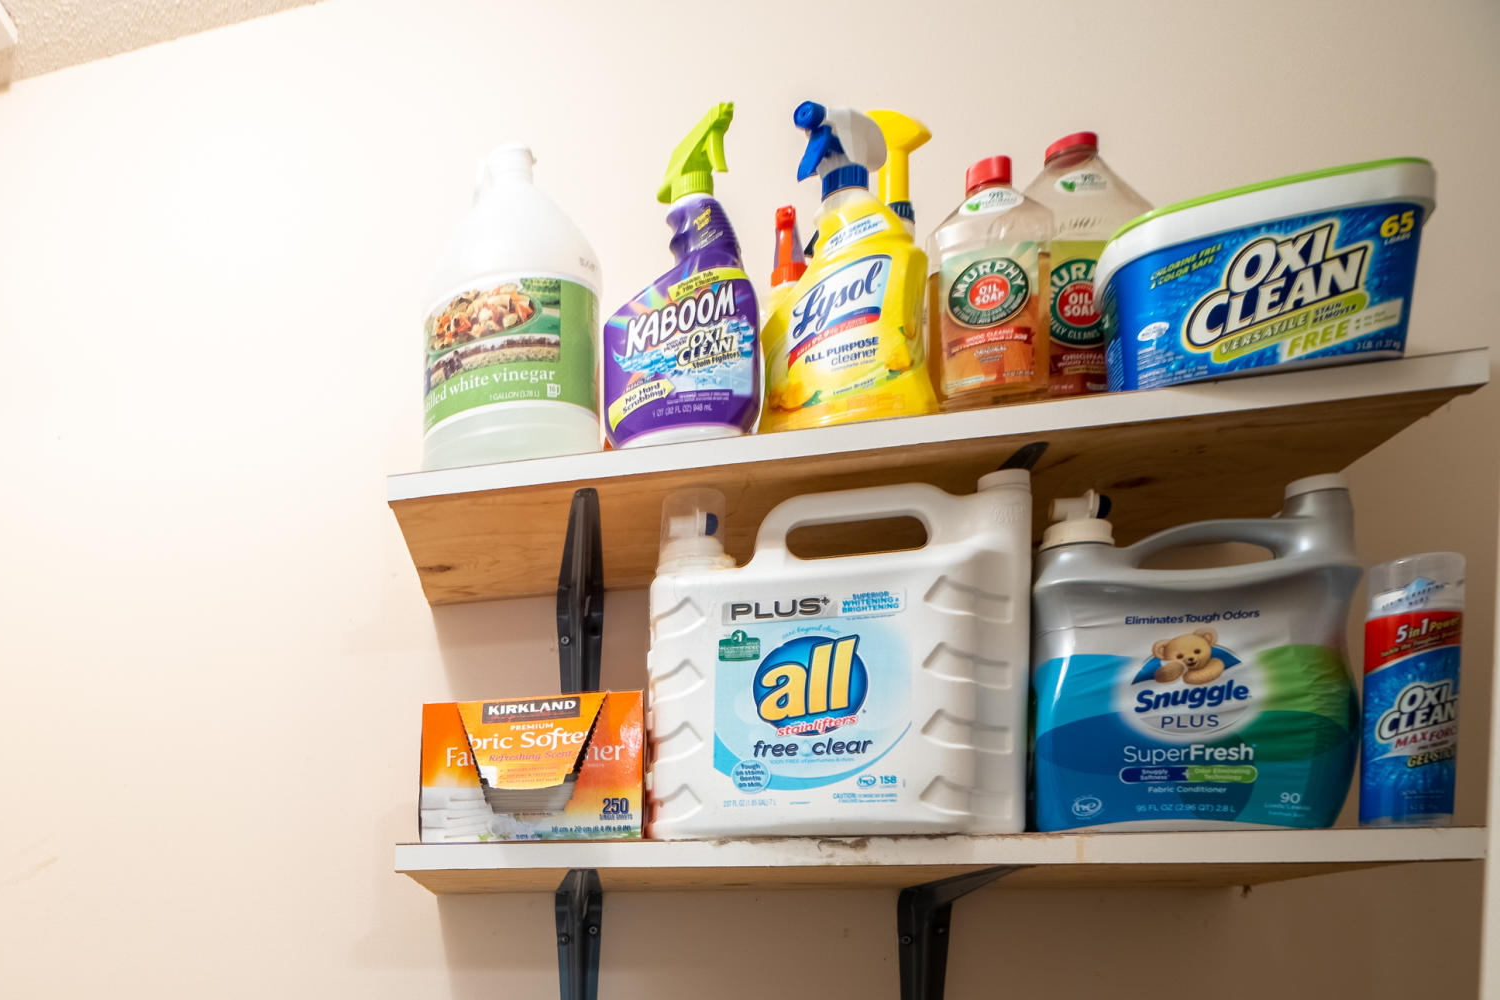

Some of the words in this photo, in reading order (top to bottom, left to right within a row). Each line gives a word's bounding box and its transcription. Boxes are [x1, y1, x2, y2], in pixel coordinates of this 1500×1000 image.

[1380, 211, 1415, 238] 65
[1151, 253, 1197, 280] CHLORINE
[1199, 243, 1222, 259] FREE
[1227, 223, 1333, 293] OXI
[953, 261, 1026, 298] MURPHY
[1157, 265, 1190, 285] COLOR
[1191, 256, 1214, 271] SAFE
[792, 260, 883, 339] Lysol
[975, 290, 1005, 305] SOAP
[979, 284, 999, 295] OIL
[1069, 293, 1092, 304] OIL
[1187, 246, 1368, 346] CLEAN
[1314, 304, 1357, 323] REMOVER
[1315, 303, 1341, 315] STAIN
[625, 281, 735, 358] KABOOM
[689, 327, 720, 348] OXI
[1219, 314, 1308, 355] VERSATILE
[1288, 320, 1349, 357] FREE
[677, 335, 734, 366] CLEAN
[693, 358, 710, 369] Stain
[712, 351, 740, 364] Fighters
[805, 351, 824, 364] ALL
[827, 336, 879, 356] PURPOSE
[831, 348, 878, 366] cleaner
[450, 374, 489, 396] white
[493, 368, 556, 383] vinegar
[625, 394, 637, 405] No
[639, 383, 660, 395] Hard
[842, 597, 894, 606] WHITENING
[852, 591, 889, 599] SUPERIOR
[842, 603, 899, 613] BRIGHTENING
[1125, 614, 1183, 625] Eliminates
[1184, 613, 1220, 624] Tough
[1223, 609, 1260, 620] Odors
[1396, 624, 1409, 643] 5
[1409, 627, 1420, 639] in
[1421, 618, 1429, 635] 1
[759, 637, 857, 720] all
[1135, 679, 1249, 713] Snuggle
[1400, 684, 1449, 713] OXI
[488, 700, 576, 716] KIRKLAND
[510, 723, 554, 731] PREMIUM
[777, 714, 858, 736] stainlifters
[1161, 714, 1219, 729] PLUS
[1380, 698, 1458, 739] CLEAN
[754, 740, 798, 758] free
[811, 738, 873, 754] clear
[1395, 730, 1428, 748] MAX
[489, 751, 541, 762] Refreshing
[545, 750, 572, 759] Scent
[1123, 743, 1254, 765] SuperFresh
[880, 776, 897, 784] 158
[1141, 768, 1168, 776] Snuggly
[1148, 786, 1174, 794] Fabric
[1177, 785, 1227, 794] Conditioner
[1280, 792, 1300, 804] 90
[603, 798, 629, 814] 250
[1149, 804, 1159, 812] FL
[1161, 804, 1173, 812] OZ
